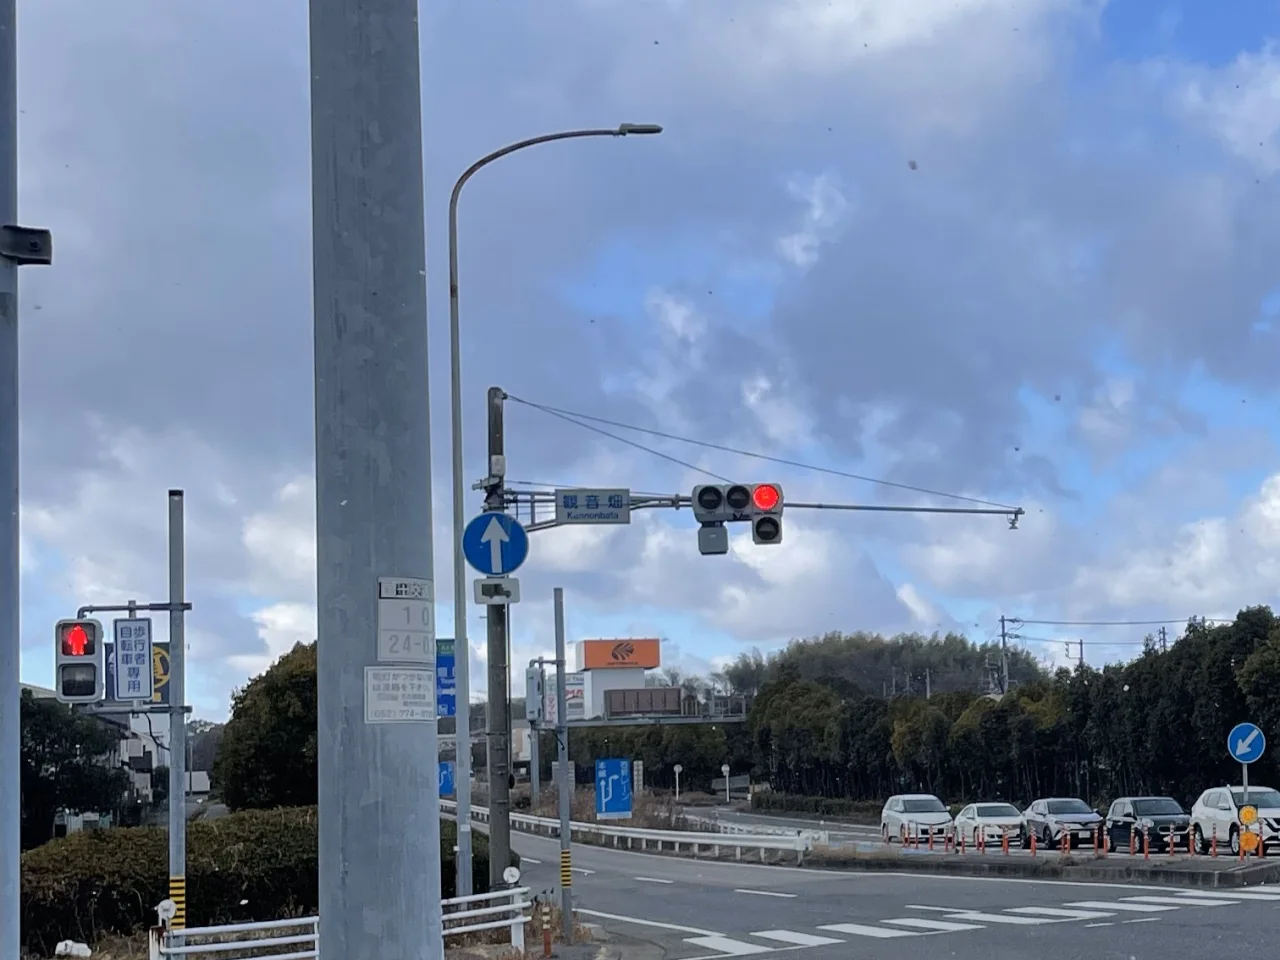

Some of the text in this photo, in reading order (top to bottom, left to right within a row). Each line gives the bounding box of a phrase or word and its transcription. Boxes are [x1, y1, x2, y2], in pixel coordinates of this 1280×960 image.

[563, 494, 623, 509] 観音畑
[567, 511, 619, 520] Kannonbata
[120, 627, 133, 665] 自転車
[133, 626, 146, 665] 歩行者
